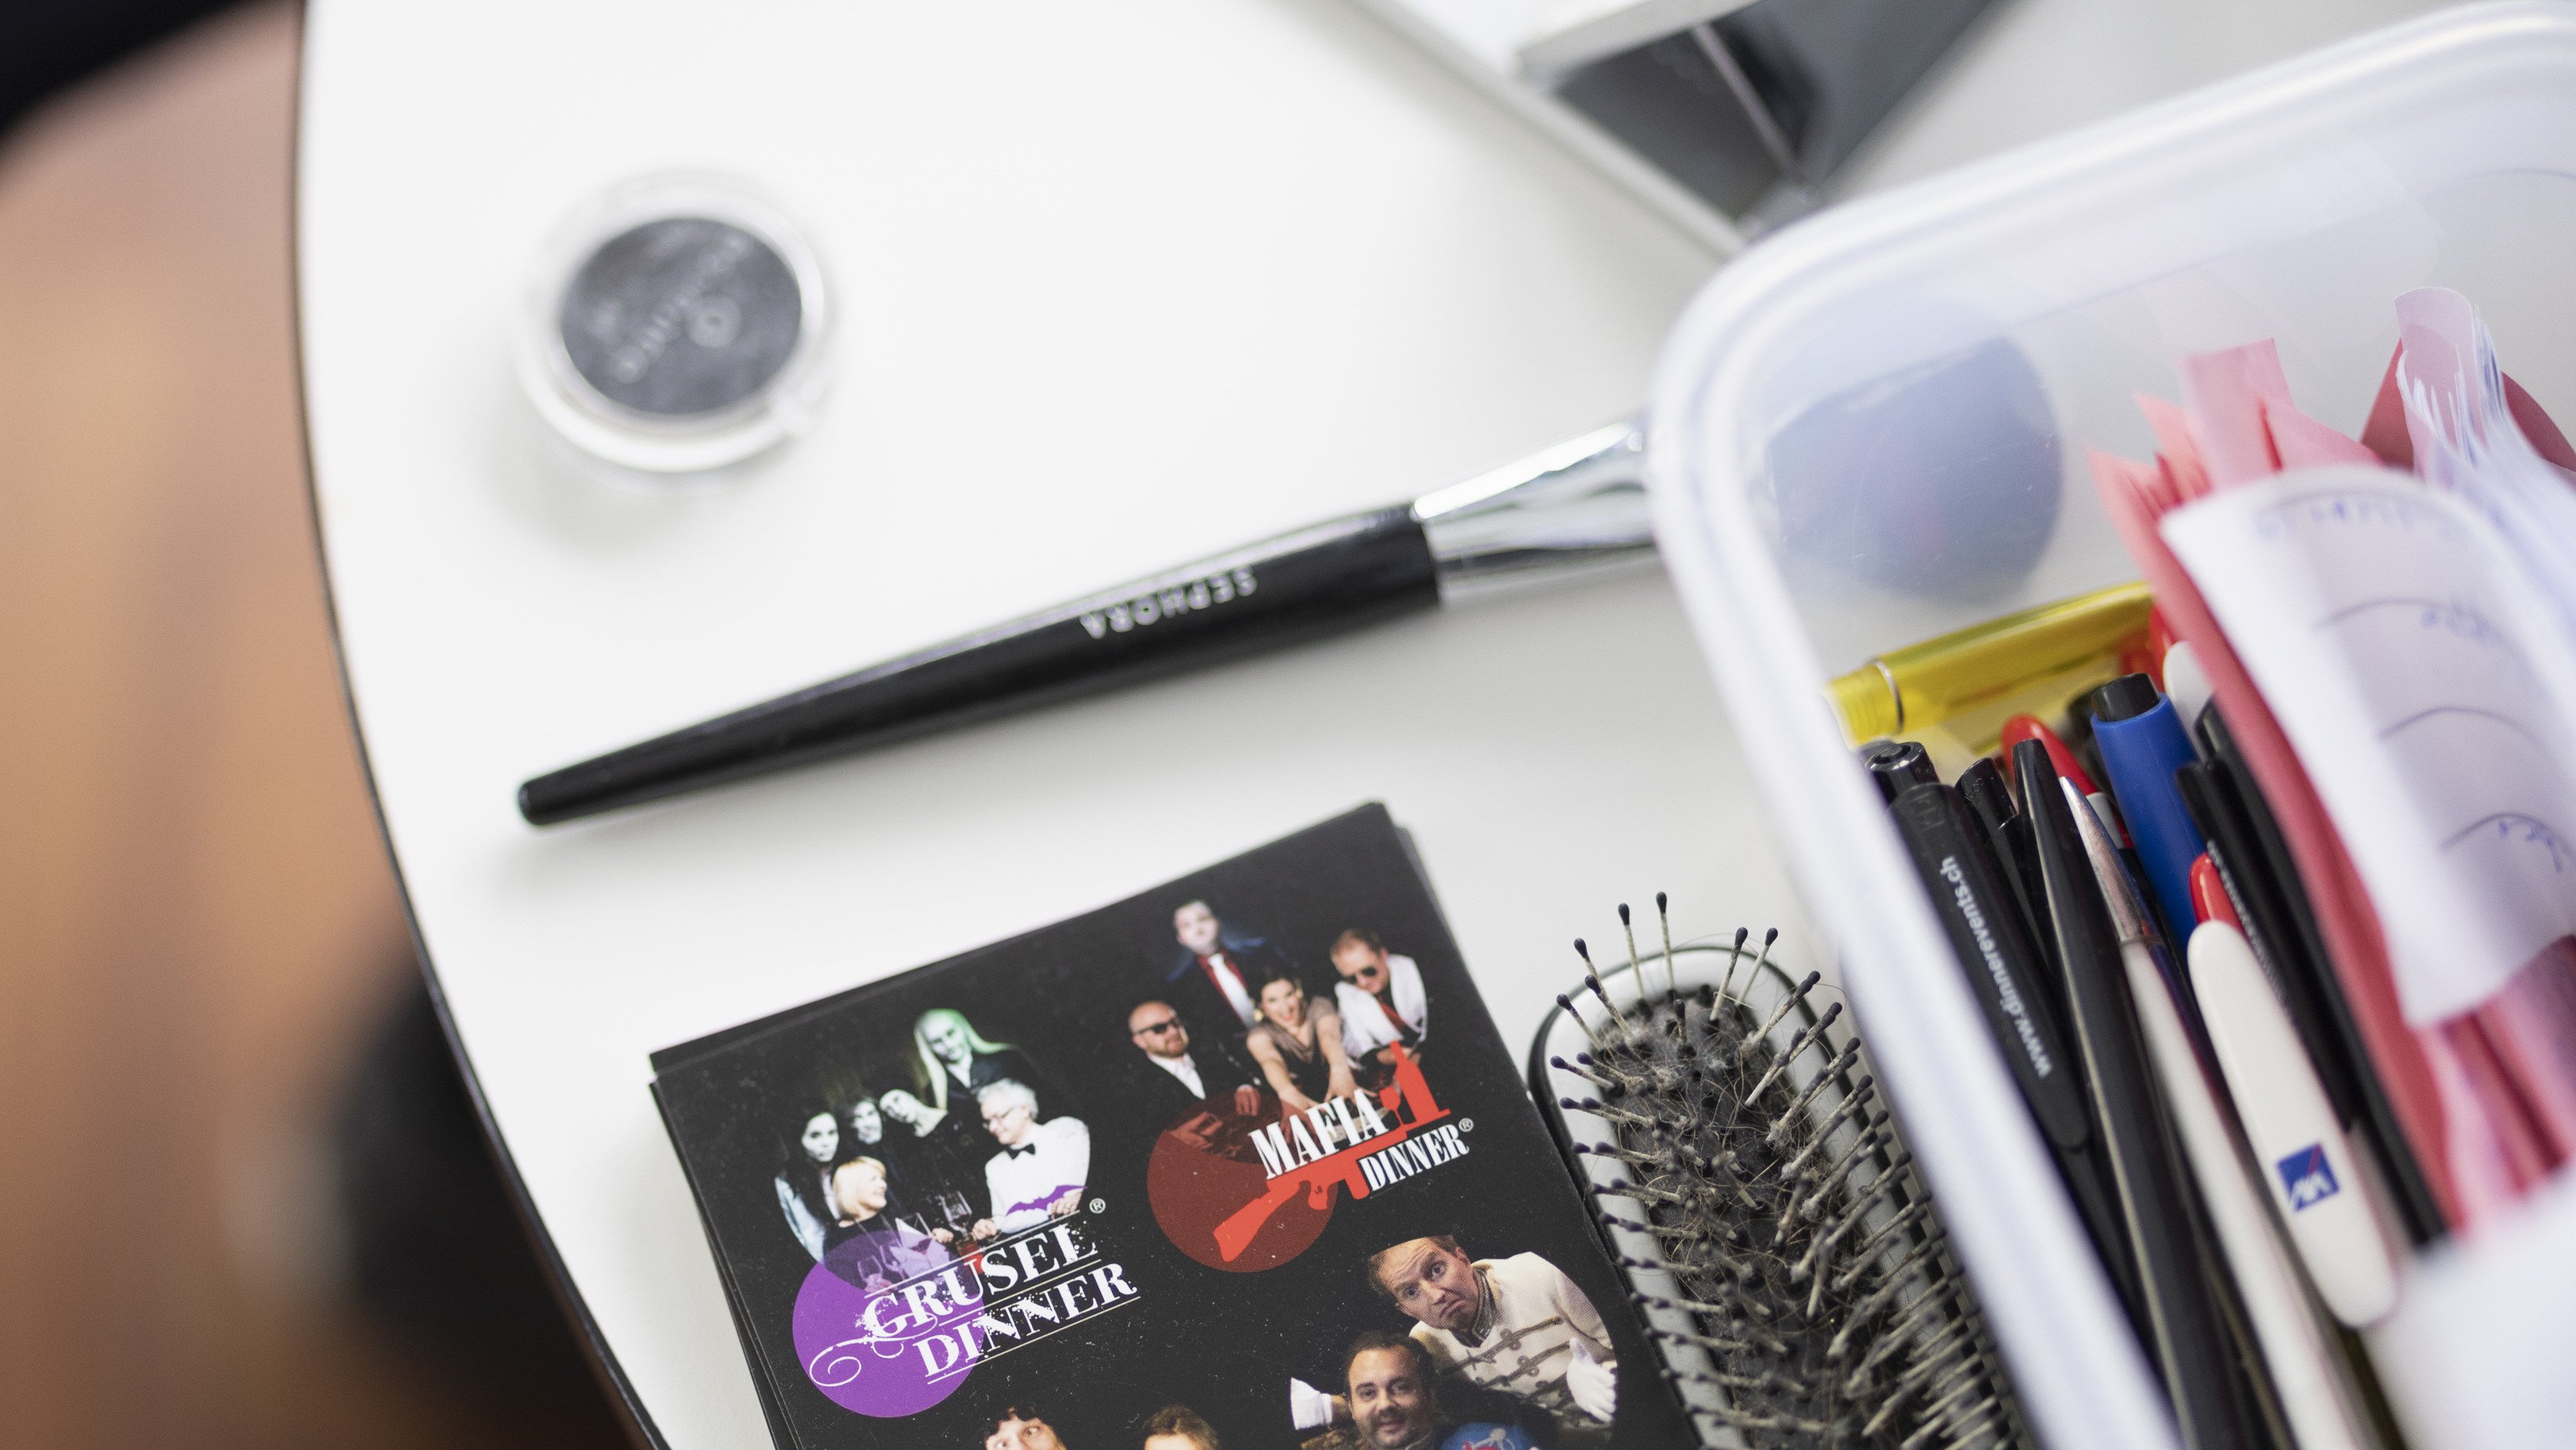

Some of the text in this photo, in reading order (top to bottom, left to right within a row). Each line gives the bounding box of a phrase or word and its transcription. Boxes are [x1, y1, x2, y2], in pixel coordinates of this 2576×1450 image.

[1078, 566, 1258, 639] SEPHORA
[1939, 855, 2052, 1079] www.dinnerevents.ch
[1247, 1088, 1390, 1180] MAFIA
[912, 1262, 1138, 1378] DINNER
